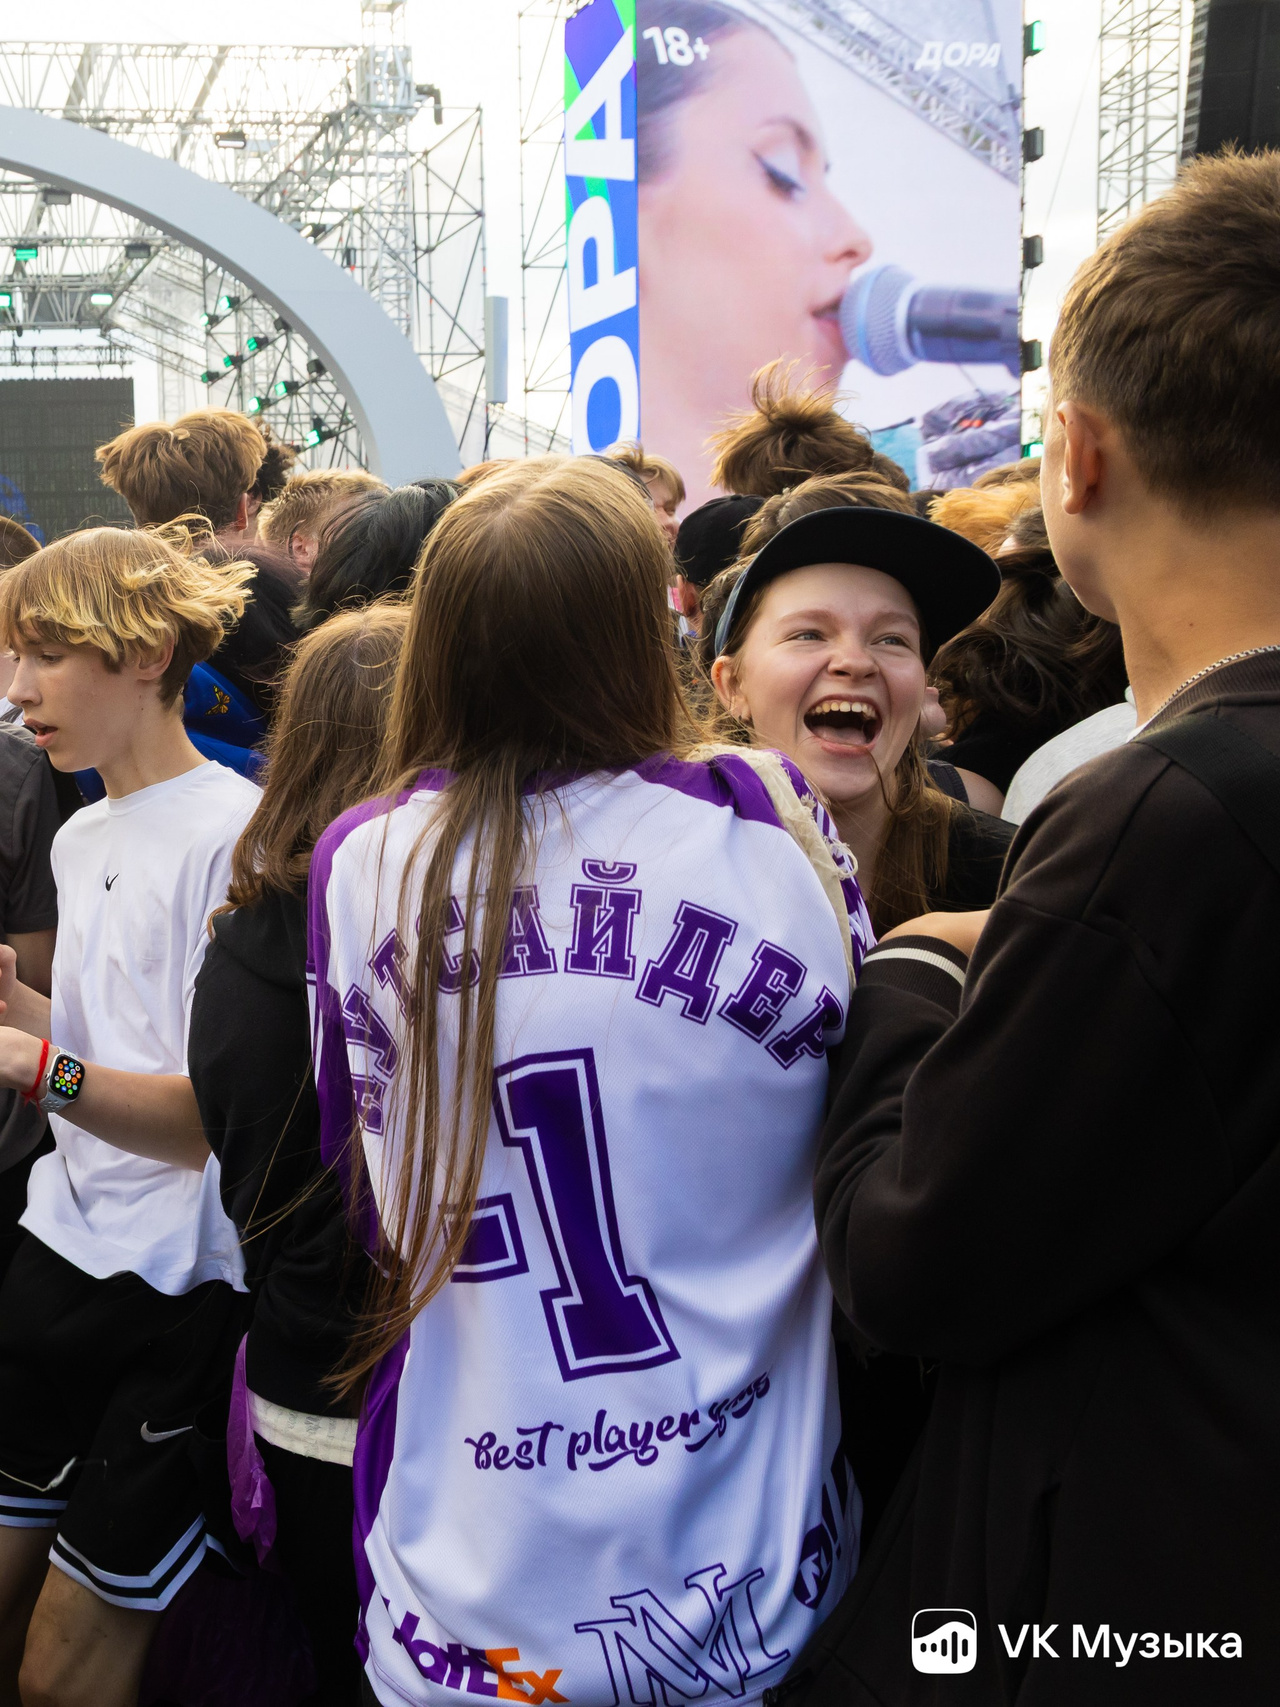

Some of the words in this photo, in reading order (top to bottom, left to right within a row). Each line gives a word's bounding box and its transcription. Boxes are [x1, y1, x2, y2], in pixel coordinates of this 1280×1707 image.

[642, 26, 711, 67] 18+
[915, 40, 1002, 72] ДОРА
[566, 24, 639, 457] ОРА
[566, 1408, 701, 1472] player
